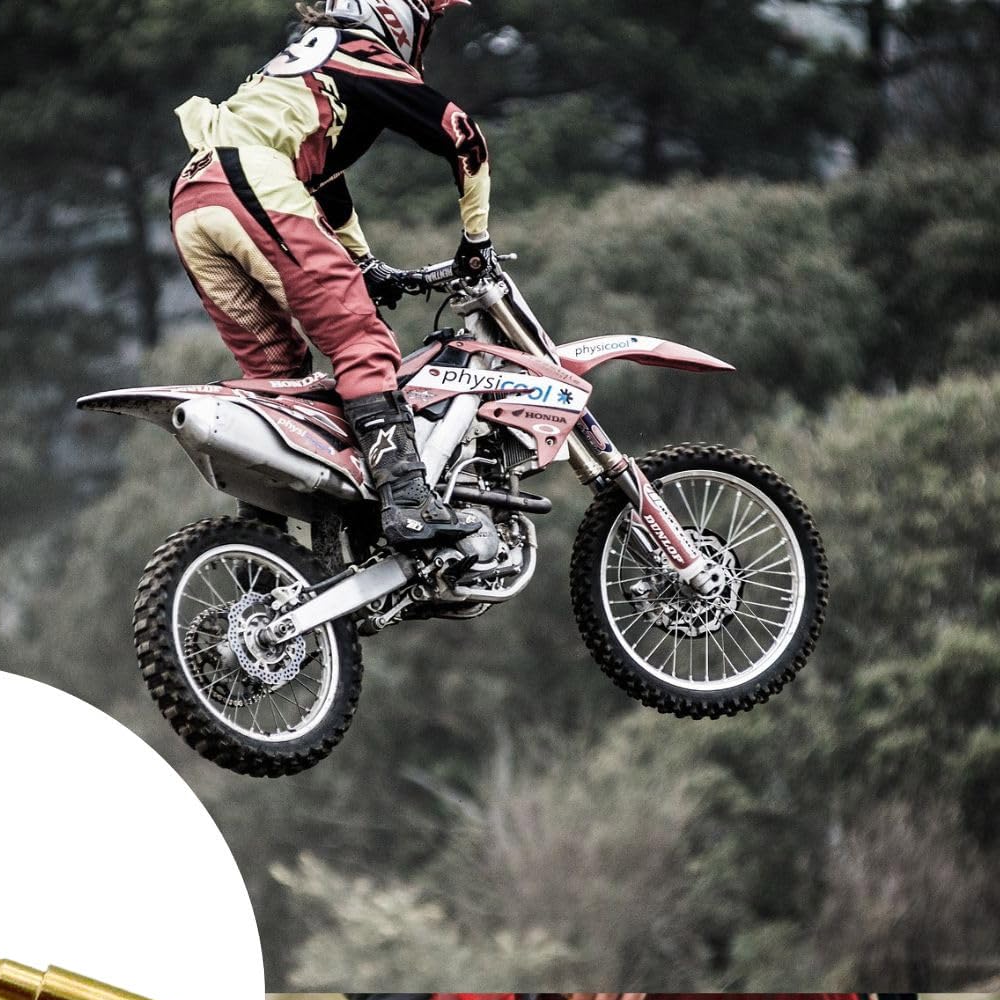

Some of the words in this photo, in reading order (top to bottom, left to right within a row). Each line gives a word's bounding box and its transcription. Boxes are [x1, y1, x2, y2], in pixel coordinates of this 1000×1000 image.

[371, 0, 411, 48] OX
[575, 340, 630, 358] physicool
[270, 371, 328, 388] HONDA
[525, 411, 568, 424] HONDA
[643, 514, 685, 564] DUNLOP
